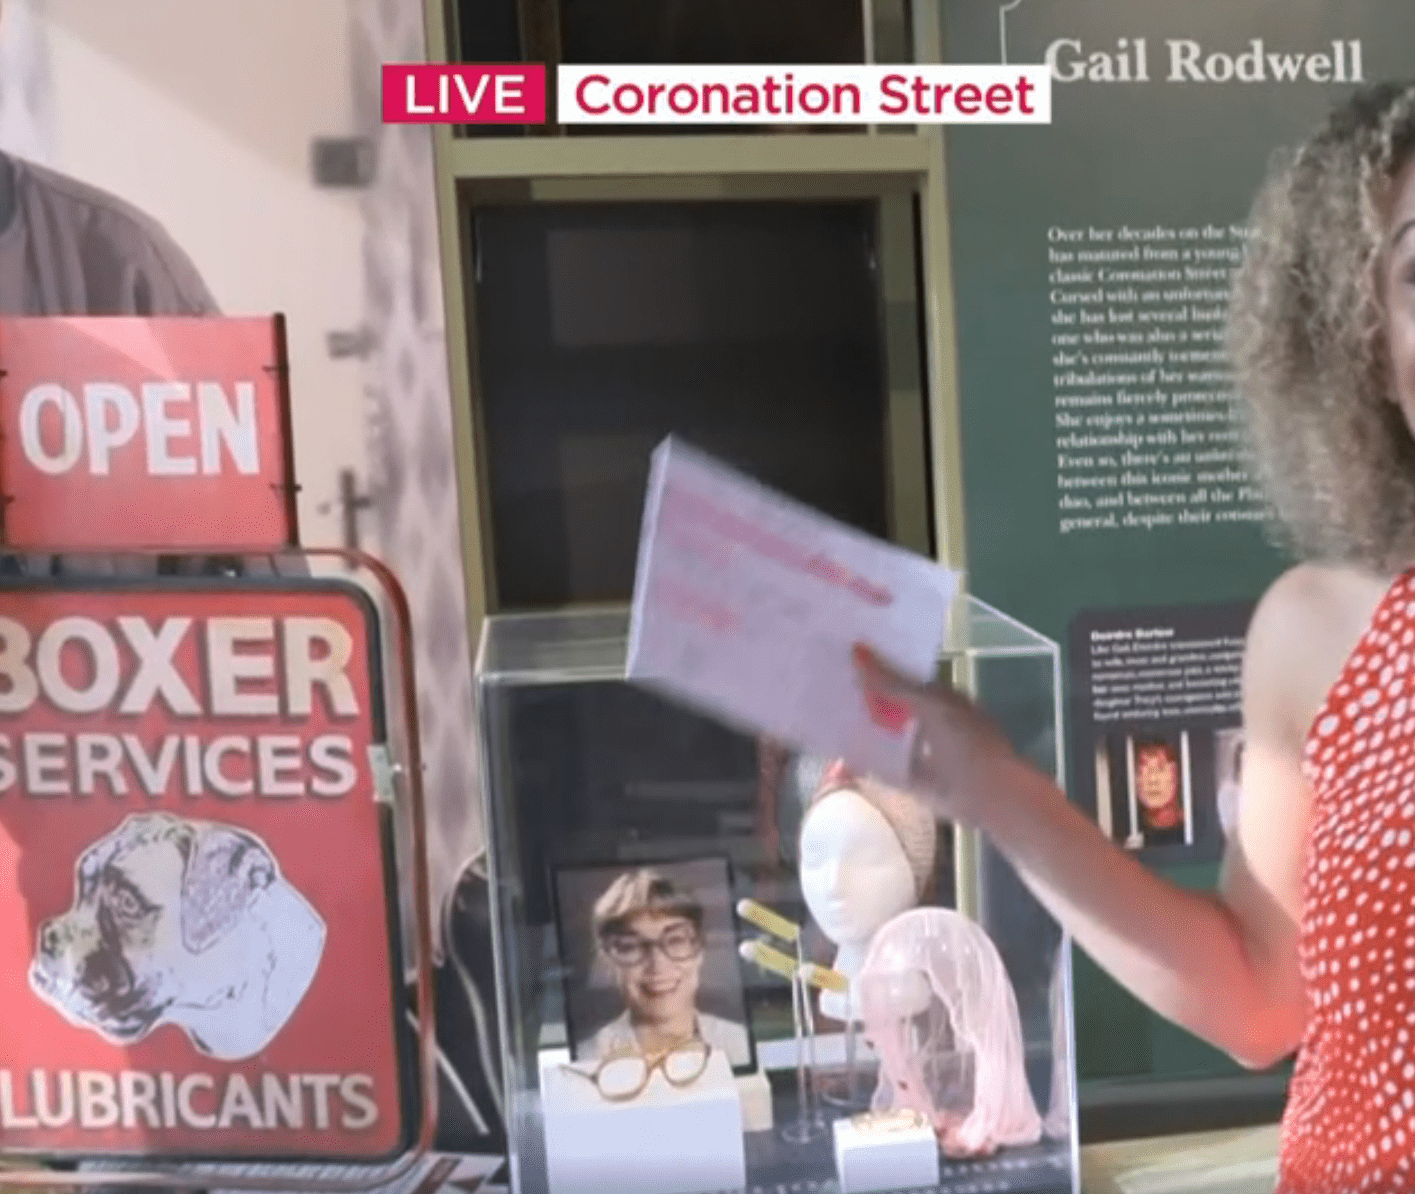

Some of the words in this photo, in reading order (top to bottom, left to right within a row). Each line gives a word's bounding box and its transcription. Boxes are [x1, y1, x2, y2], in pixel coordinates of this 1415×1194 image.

[1045, 38, 1150, 83] Gail
[1166, 38, 1364, 83] Rodwell
[1048, 225, 1083, 241] Over
[1089, 224, 1113, 240] her
[1118, 223, 1176, 240] decades
[1179, 227, 1198, 239] on
[1202, 223, 1225, 239] the
[20, 382, 259, 475] OPEN
[0, 615, 361, 715] BOXER
[0, 1068, 378, 1129] LUBRICANTS
